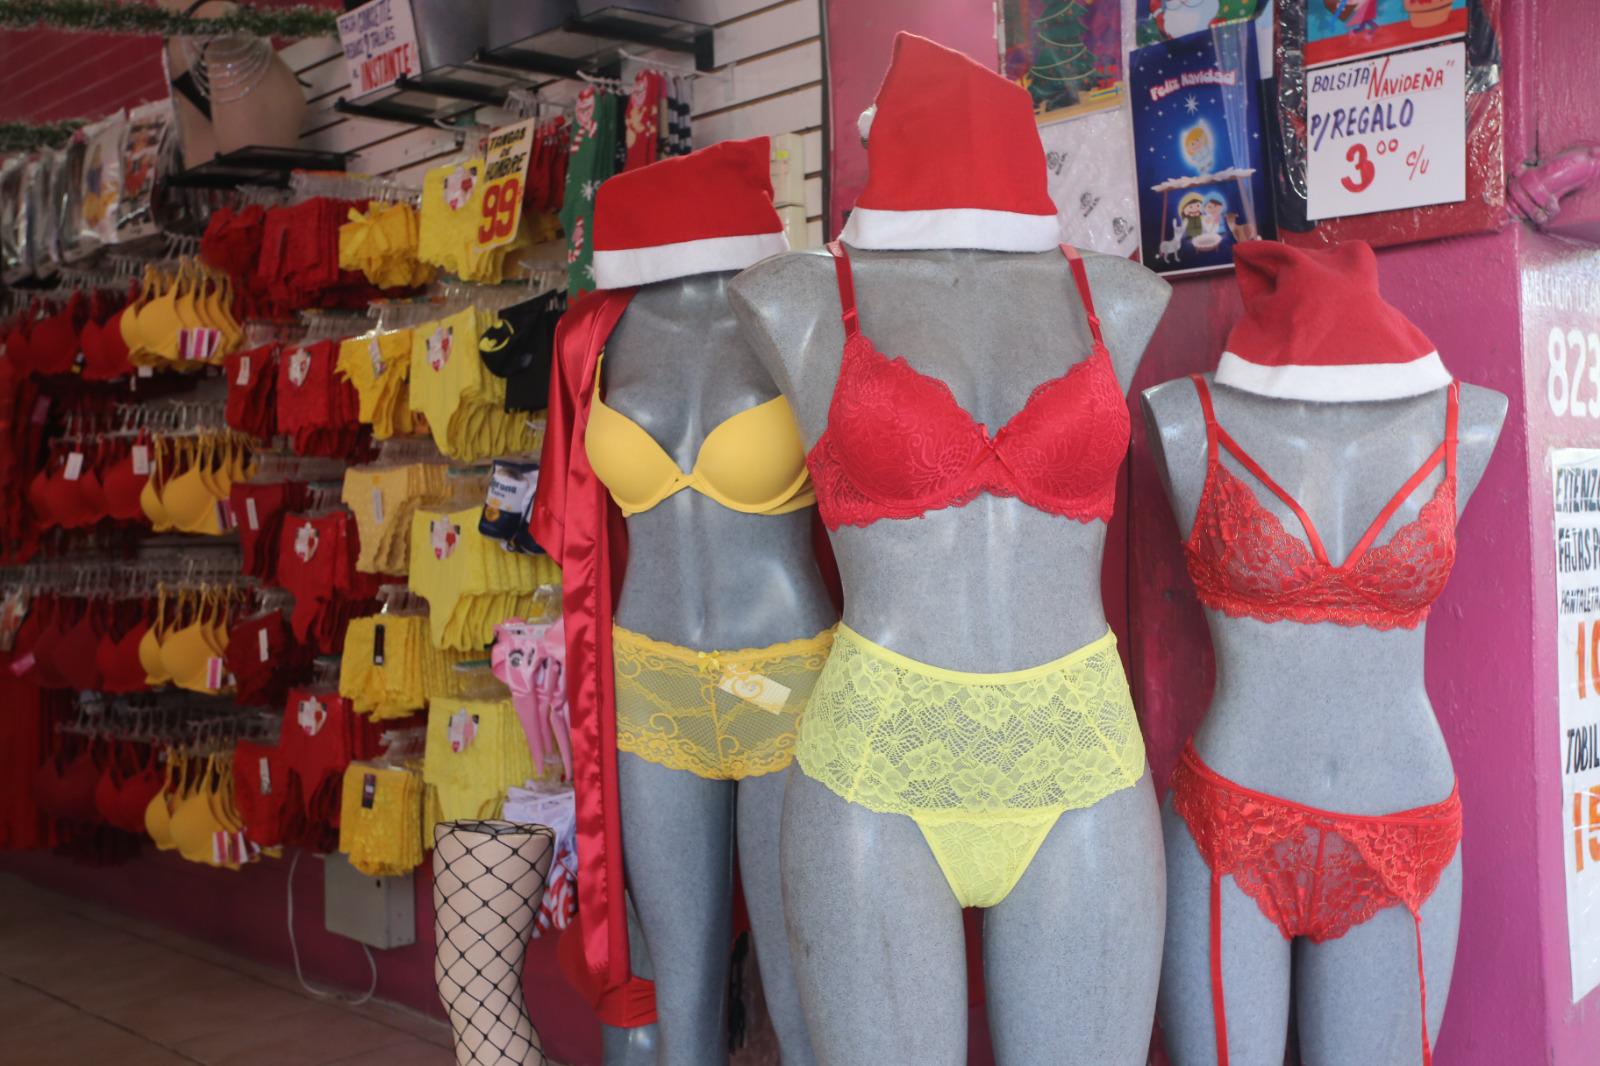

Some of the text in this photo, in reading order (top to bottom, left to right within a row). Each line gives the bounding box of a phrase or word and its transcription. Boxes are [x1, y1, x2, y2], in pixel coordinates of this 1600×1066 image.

[1150, 69, 1236, 101] Feliz Navidad
[1311, 67, 1370, 93] BOLSITA
[1310, 98, 1414, 152] P/REGALO
[1555, 467, 1600, 514] EXTENZ
[1558, 528, 1592, 574] FAJAS
